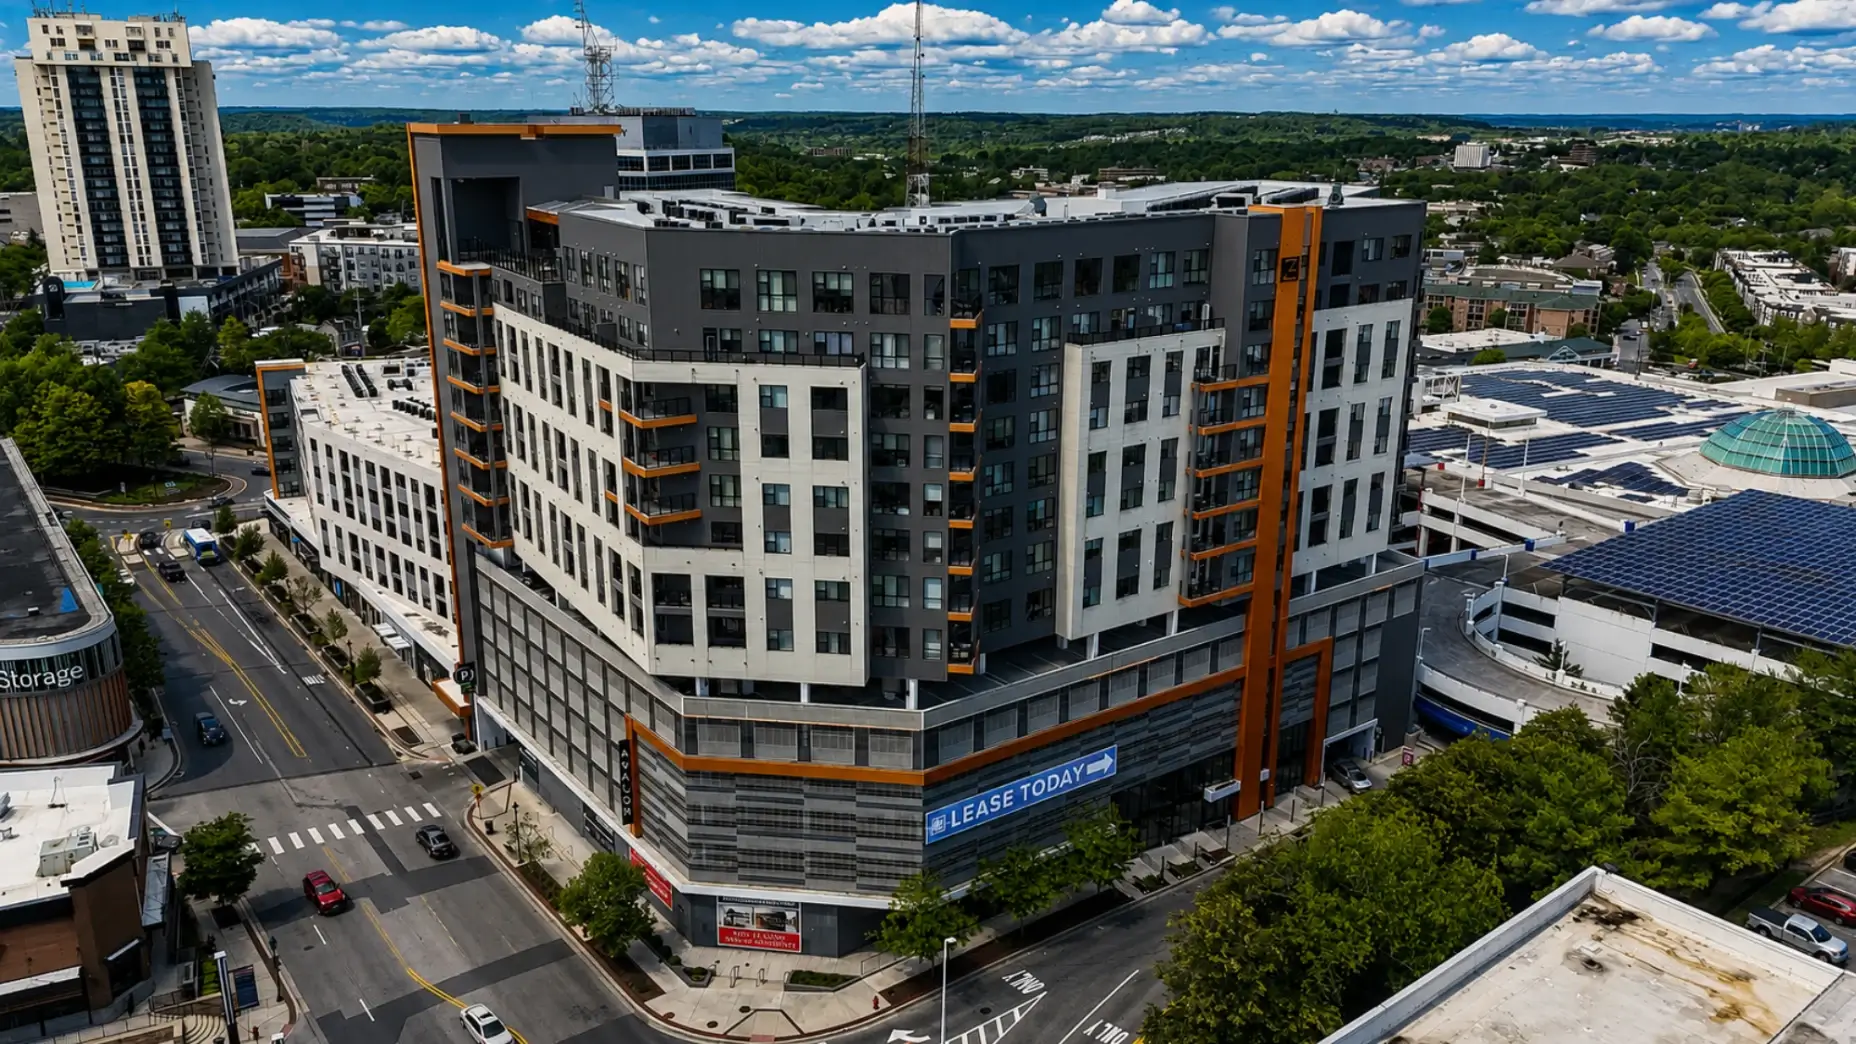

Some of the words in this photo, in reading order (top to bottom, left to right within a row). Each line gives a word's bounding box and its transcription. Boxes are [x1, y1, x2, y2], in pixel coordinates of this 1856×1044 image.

[0, 665, 84, 689] Storage
[461, 670, 469, 681] P
[951, 789, 1014, 828] LEASE
[1020, 763, 1085, 801] TODAY
[1082, 1018, 1129, 1044] ONLY
